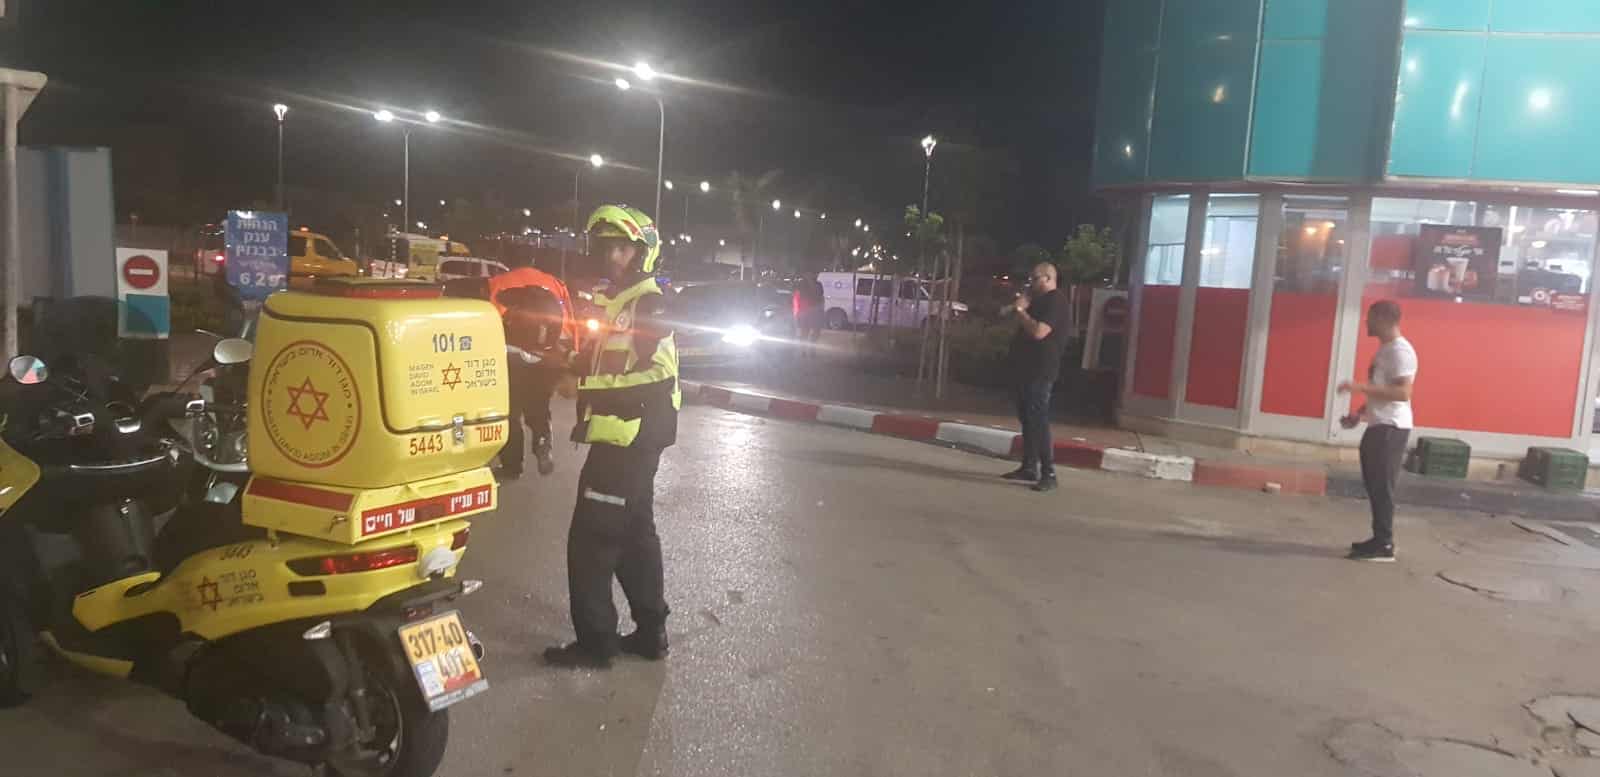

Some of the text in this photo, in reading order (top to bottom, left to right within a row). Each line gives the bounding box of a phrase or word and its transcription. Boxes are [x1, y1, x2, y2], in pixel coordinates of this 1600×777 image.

[244, 232, 270, 243] ענק
[432, 333, 455, 352] 101
[464, 358, 497, 368] מגן דוד
[475, 369, 497, 378] אדום
[475, 424, 503, 443] אשר
[409, 434, 443, 456] 5443
[477, 490, 489, 505] זה
[365, 512, 393, 533] חיים
[397, 508, 416, 524] של
[408, 622, 463, 658] 317-40
